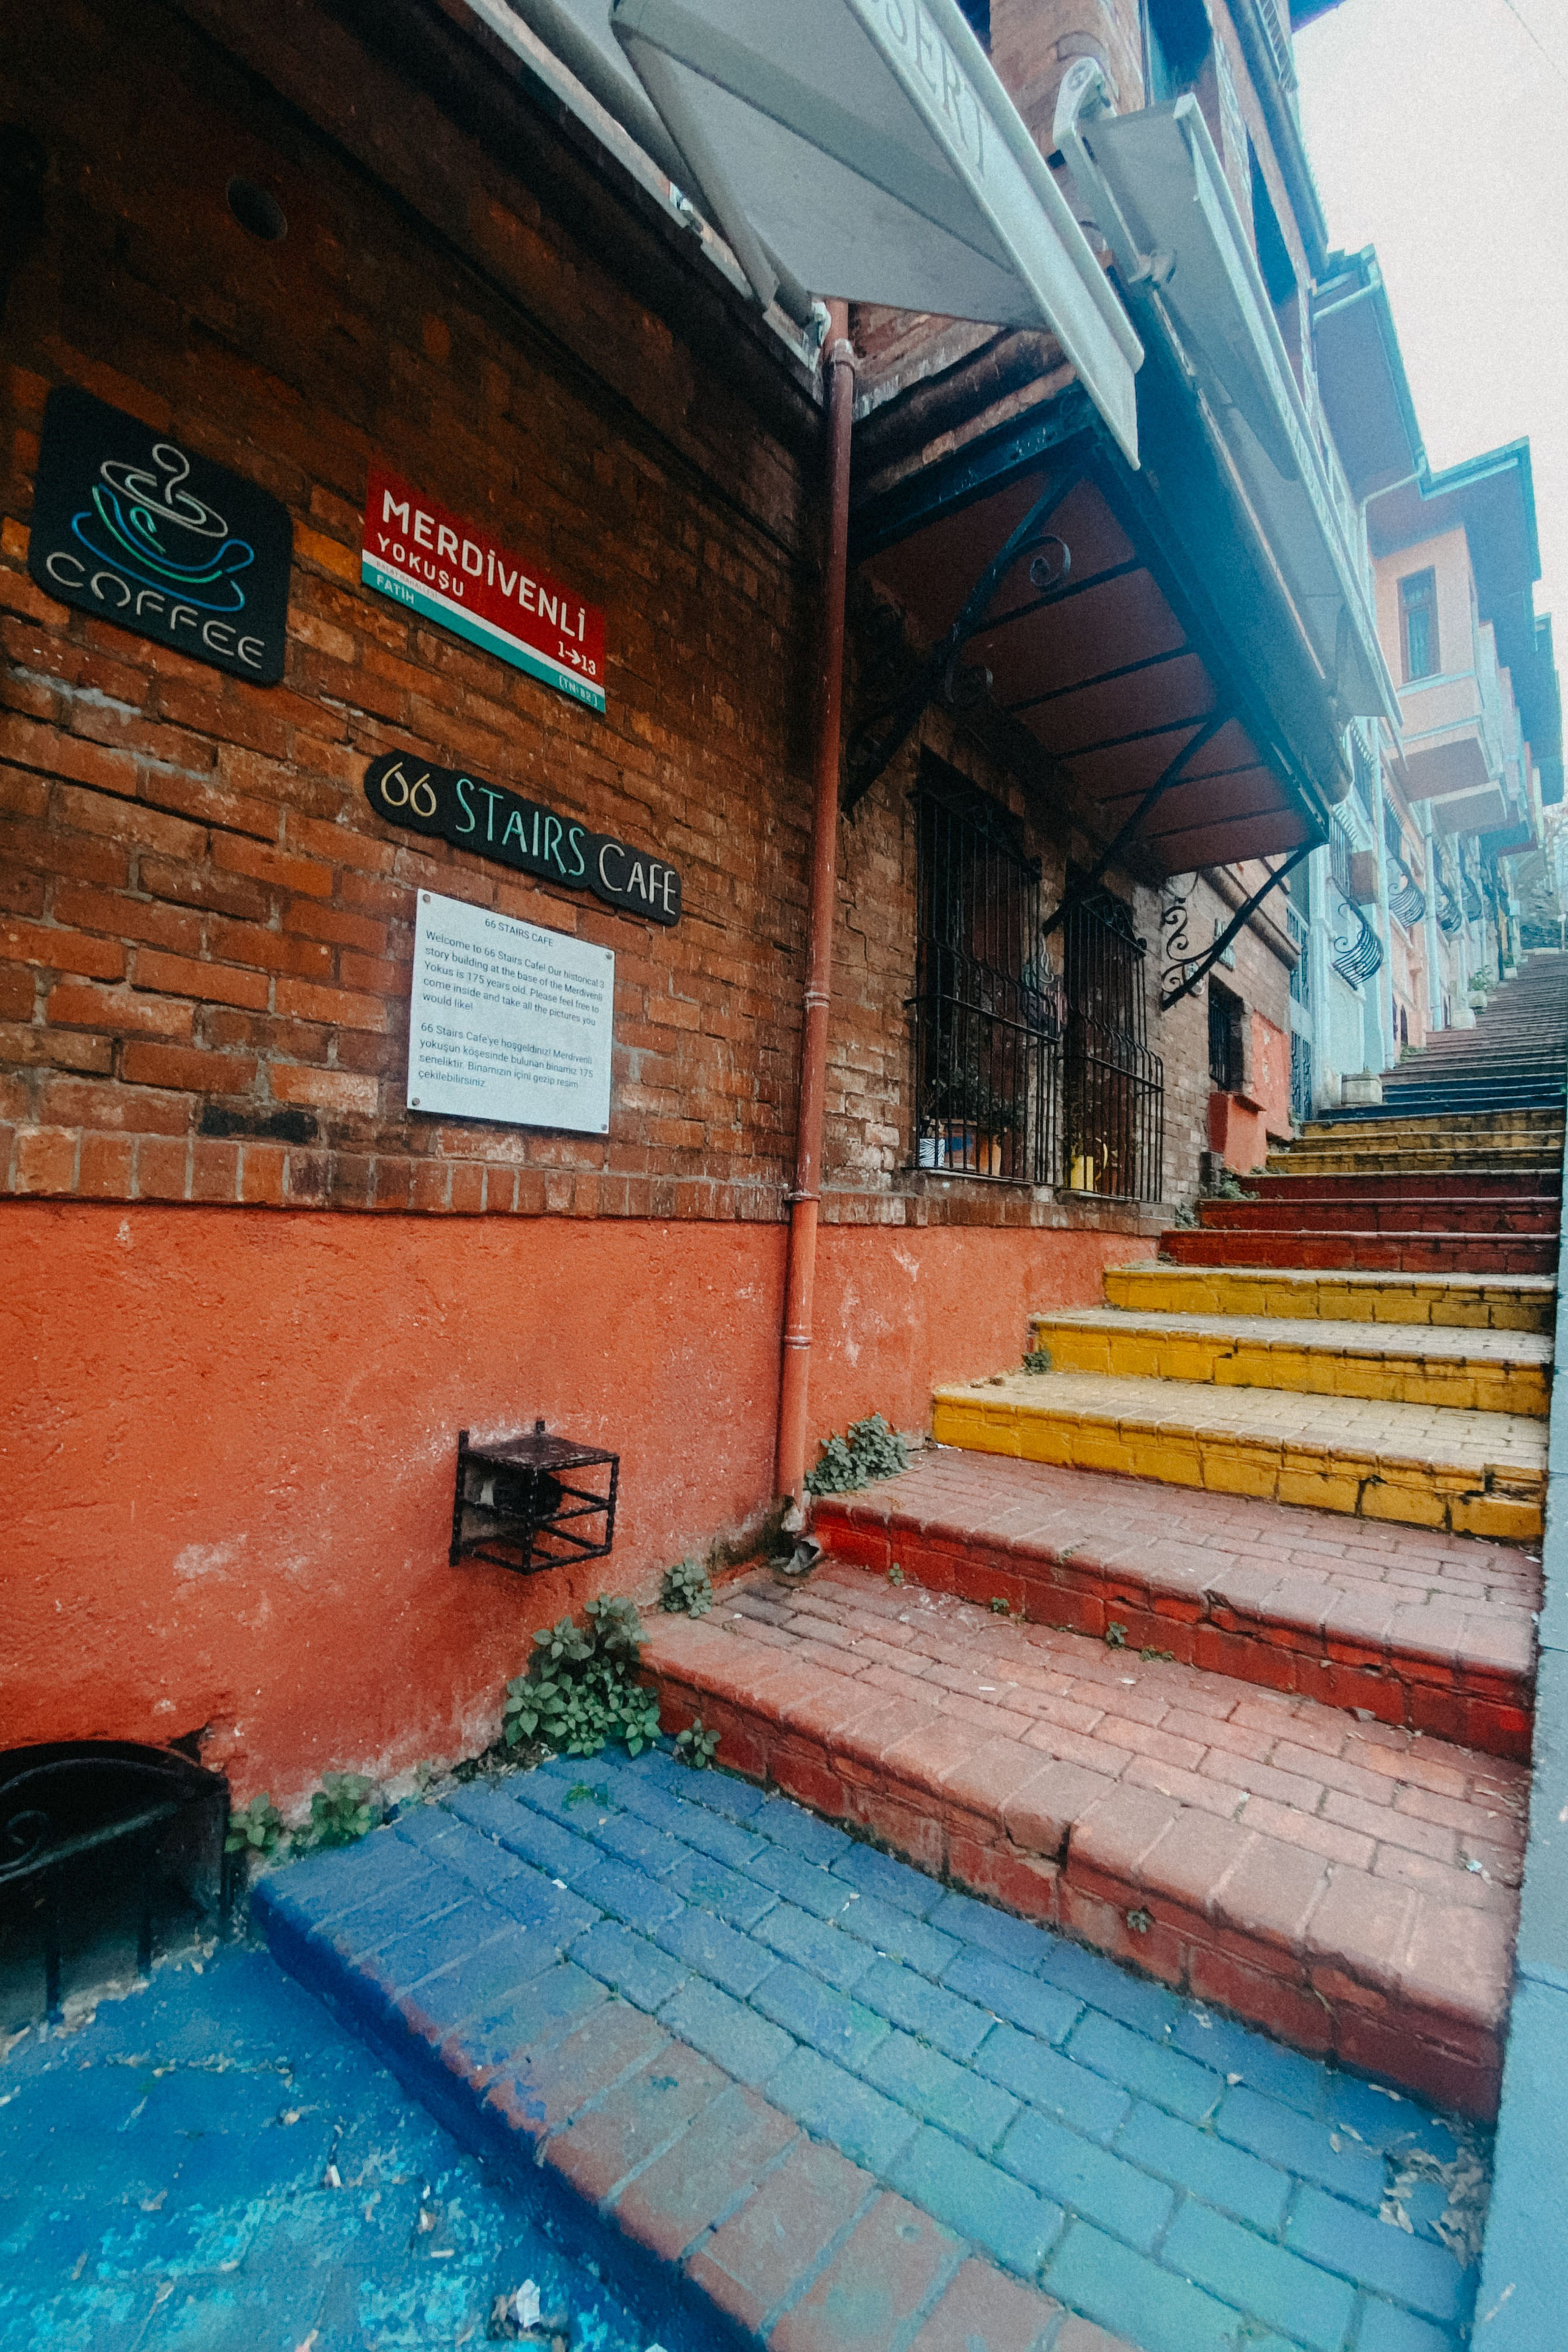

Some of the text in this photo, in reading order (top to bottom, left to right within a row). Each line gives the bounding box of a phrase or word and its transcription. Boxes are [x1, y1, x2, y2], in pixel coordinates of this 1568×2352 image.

[377, 532, 464, 597] YOKUŞU
[382, 489, 586, 641] MERDİVENLİ
[47, 552, 265, 669] COFFEE
[377, 575, 414, 605] FATİH
[380, 762, 676, 914] 66 STAIRS CAFE
[485, 919, 554, 947] 66 STAIRS CAFE
[425, 948, 450, 961] story
[452, 952, 488, 971] building
[502, 967, 515, 978] the
[518, 971, 537, 983] base
[550, 981, 562, 990] the
[565, 983, 603, 1001] Merdivenli
[426, 929, 470, 950] Welcome
[473, 944, 481, 954] to
[484, 948, 496, 957] 66
[498, 951, 522, 965] Stairs
[524, 959, 546, 971] Cafe!
[548, 965, 562, 976] Our
[564, 970, 598, 987] historical
[423, 993, 473, 1010] would like!
[423, 978, 595, 1026] come inside and take all the pictures you
[424, 960, 453, 976] Yokus
[456, 970, 464, 979] is
[467, 972, 484, 984] 175
[486, 979, 510, 990] years
[530, 988, 557, 1003] Please
[559, 997, 574, 1007] feel
[576, 1000, 592, 1011] free
[420, 1039, 461, 1054] yokuşun
[511, 1055, 544, 1069] bulunan
[546, 1062, 577, 1075] binamız
[579, 1069, 594, 1078] 175
[421, 1022, 433, 1033] 66
[436, 1025, 464, 1039] Stairs
[466, 1031, 499, 1046] Cafe'ye
[553, 1050, 592, 1065] Merdivenli
[468, 1061, 511, 1077] Binamızın
[514, 1069, 531, 1080] içini
[533, 1075, 555, 1085] gezip
[557, 1079, 578, 1088] resim
